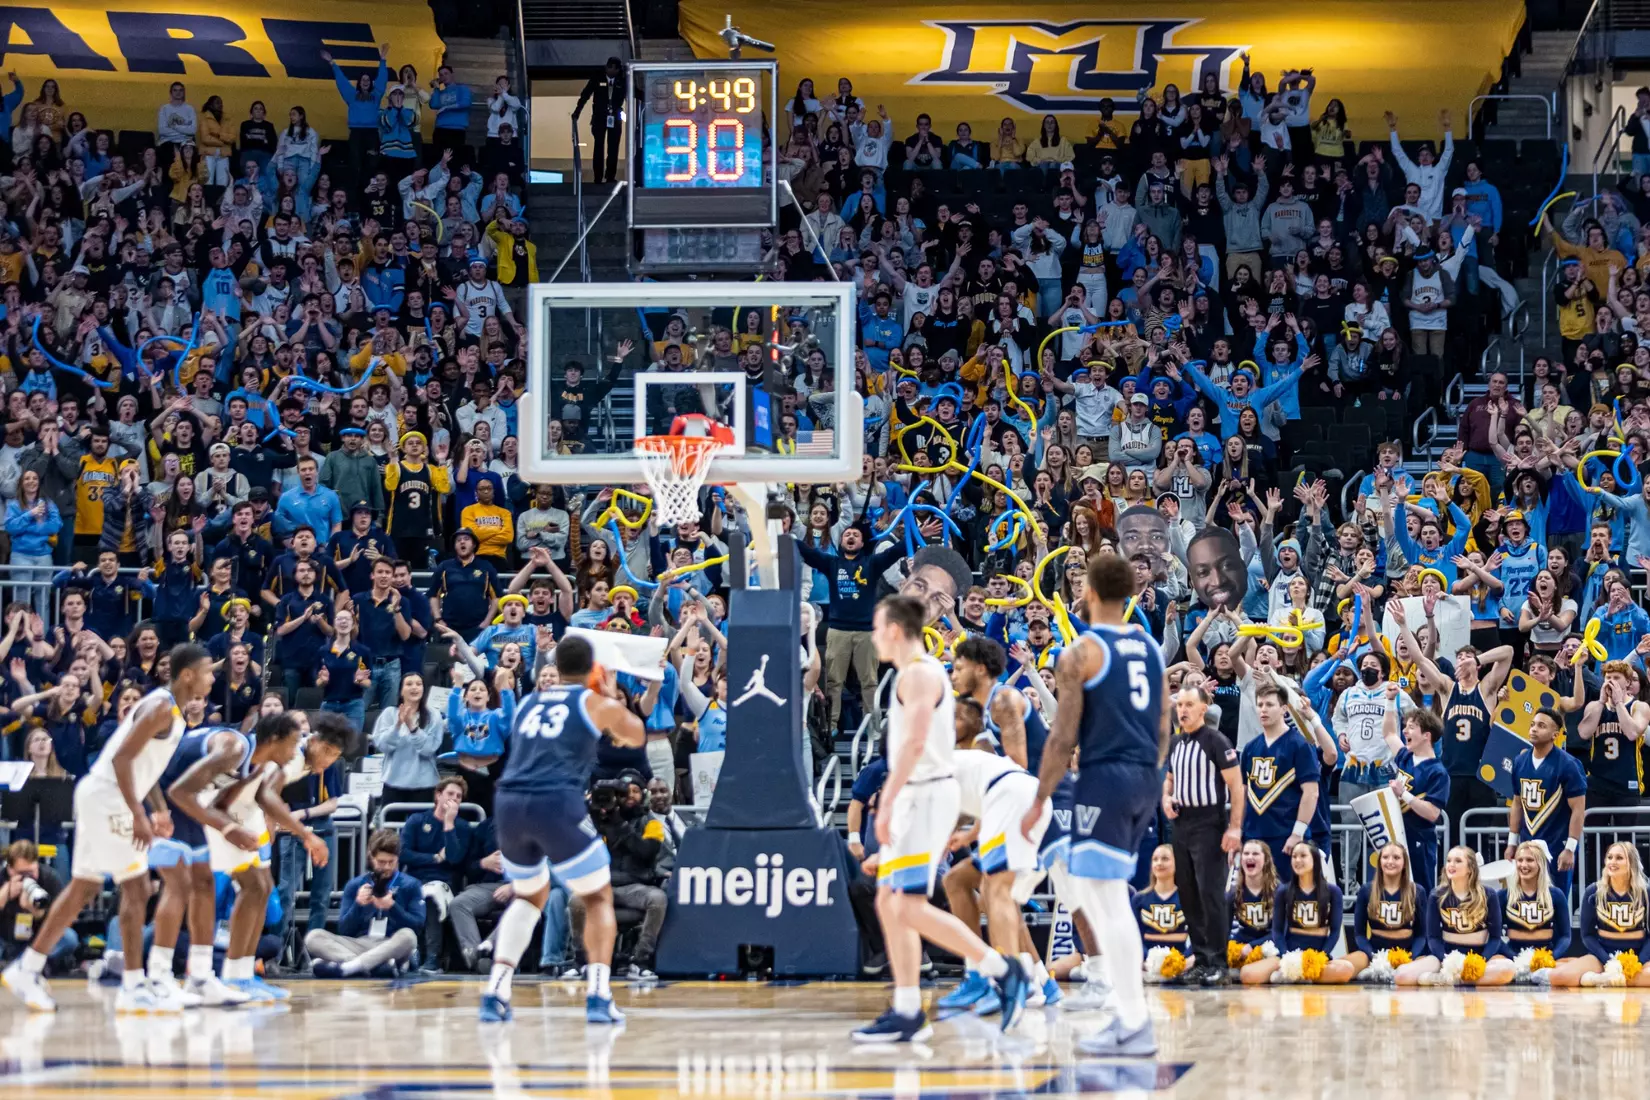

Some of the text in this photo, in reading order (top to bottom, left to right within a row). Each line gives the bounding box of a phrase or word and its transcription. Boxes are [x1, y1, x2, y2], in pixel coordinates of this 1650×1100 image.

[904, 18, 1252, 115] MU
[674, 77, 756, 113] 4:49
[664, 118, 744, 182] 30
[215, 281, 231, 295] 10
[478, 305, 488, 319] 3
[938, 446, 950, 465] 3
[400, 480, 429, 494] MARQUETTE
[1172, 475, 1194, 498] MU
[408, 491, 421, 509] 3
[1127, 660, 1151, 711] 5
[518, 703, 570, 739] 43
[1360, 717, 1375, 741] 6
[1455, 718, 1472, 742] 3
[1604, 737, 1620, 760] 3
[1251, 757, 1277, 789] MU
[1519, 777, 1546, 811] MU
[1075, 804, 1101, 836] V
[677, 853, 837, 918] meijer
[1150, 903, 1178, 930] MU
[1244, 902, 1271, 928] MU
[1295, 901, 1319, 928] MU
[1379, 901, 1402, 927] MU
[1517, 900, 1544, 925] MU
[1608, 901, 1637, 927] MU
